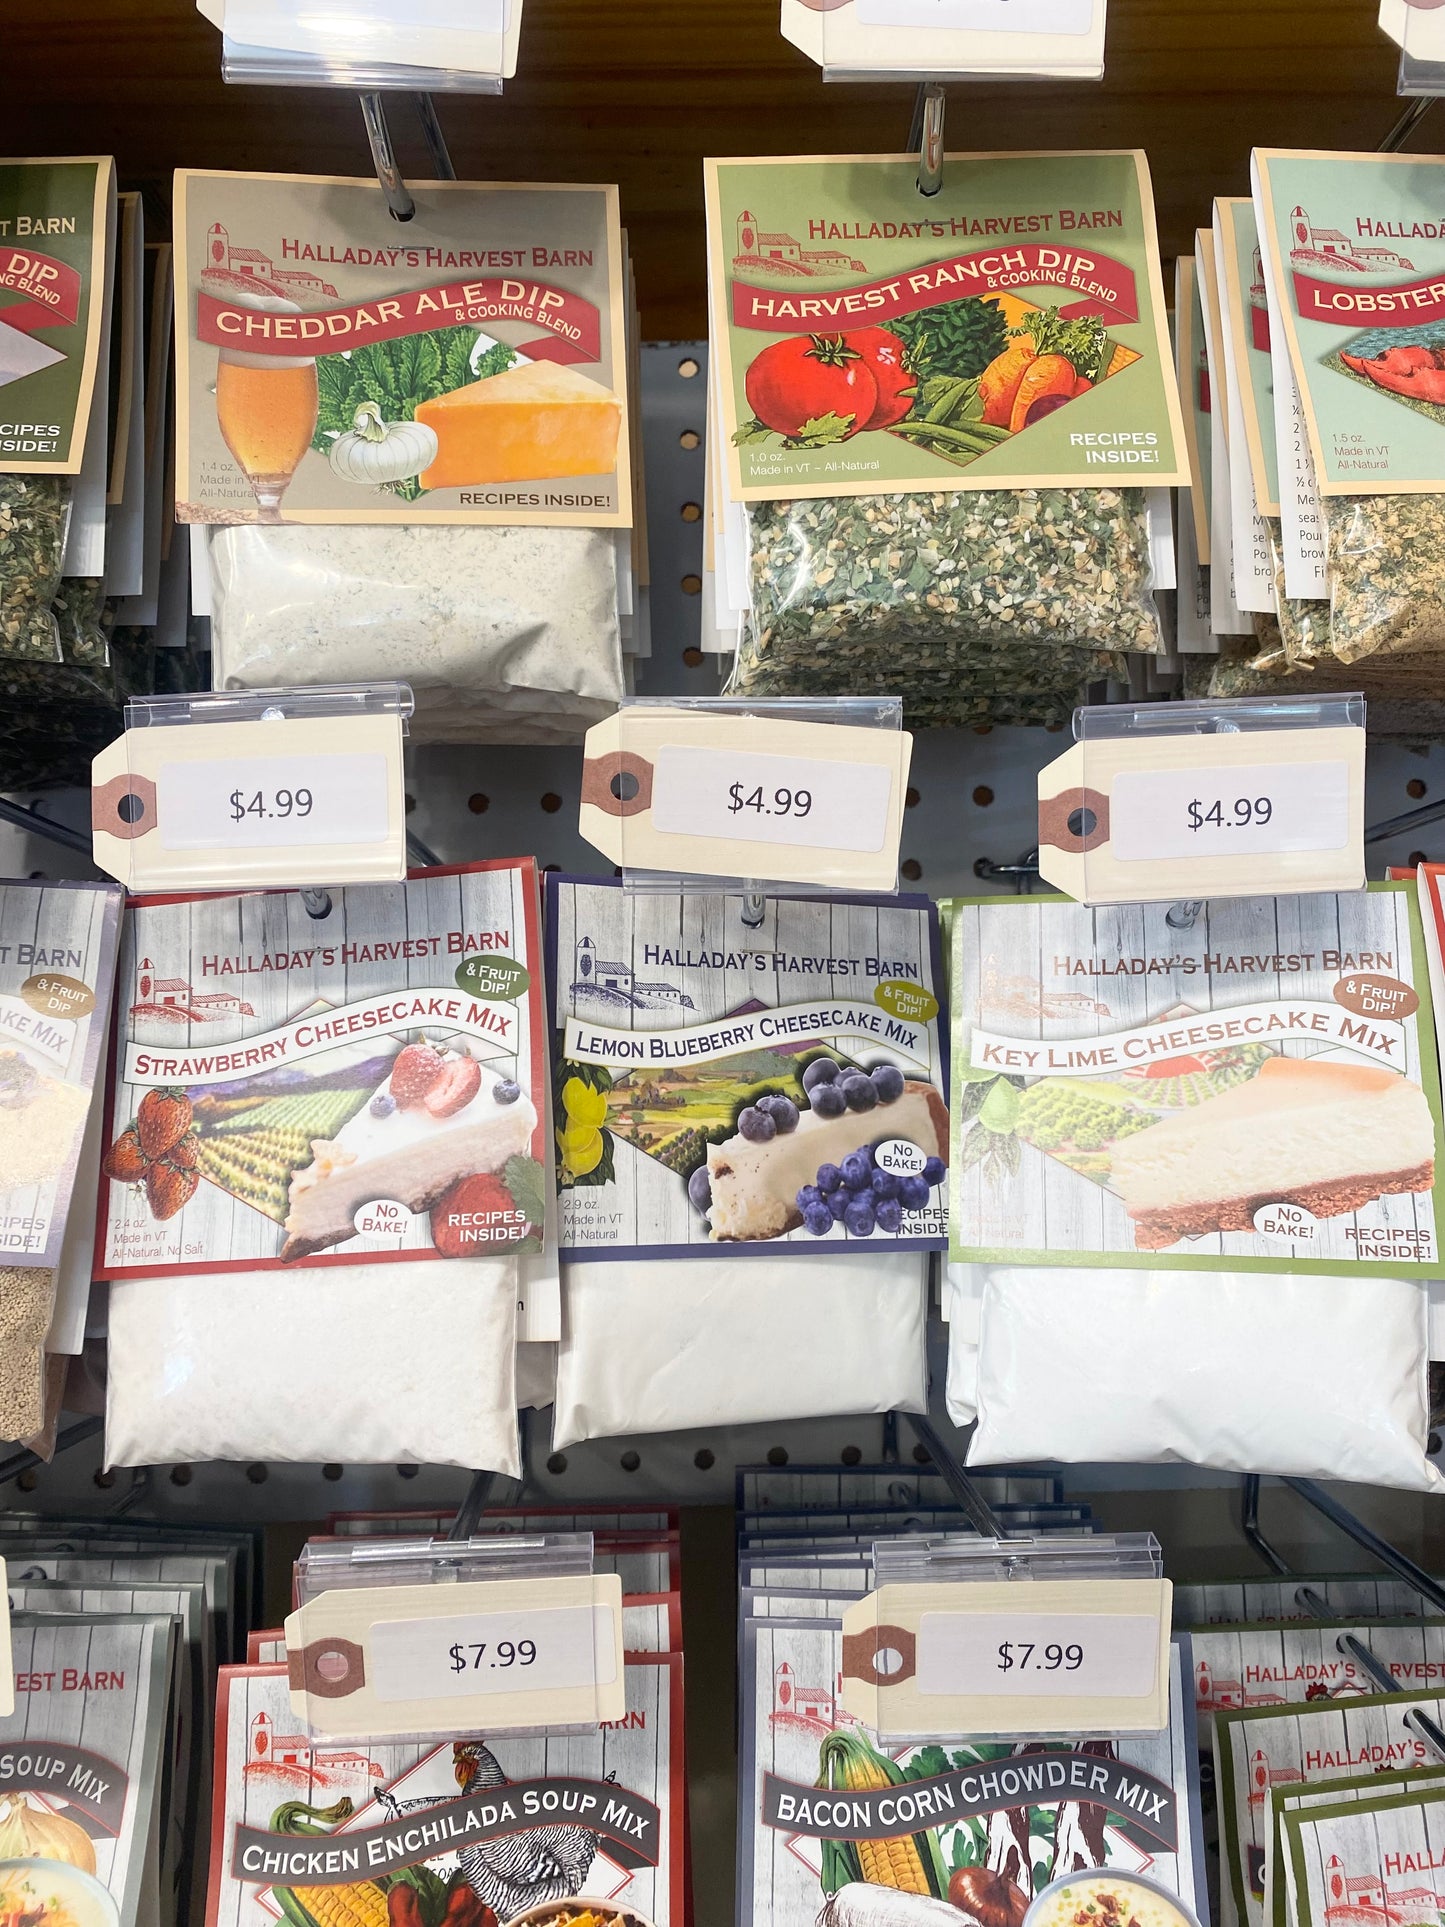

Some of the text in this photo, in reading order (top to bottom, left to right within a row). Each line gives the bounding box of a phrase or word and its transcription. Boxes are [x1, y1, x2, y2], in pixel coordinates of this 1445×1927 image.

[7, 254, 59, 283] DIP
[17, 277, 61, 305] BLEND
[751, 249, 1096, 318] HARVEST RANCH DIP
[986, 268, 1118, 302] & COOKING BLEND
[216, 280, 565, 340] CHEDDAR ALE DIP
[455, 303, 582, 341] & COOKING BLEND
[0, 424, 61, 437] CIPES
[1293, 422, 1300, 433] 2
[1294, 440, 1301, 451] 2
[1332, 433, 1348, 443] 1.5
[0, 440, 57, 452] SIDE!
[1070, 432, 1160, 463] RECIPES INSIDE!
[1334, 446, 1390, 456] Made in VT
[750, 453, 786, 462] 1.0 oz.
[1337, 460, 1389, 469] All-Natural
[201, 462, 217, 471] 1.4
[750, 465, 781, 476] Made
[783, 464, 793, 474] in
[796, 463, 811, 473] VT
[825, 460, 880, 471] All-Natural
[200, 475, 231, 485] Made
[235, 475, 244, 485] in
[459, 493, 611, 507] RECIPES INSIDE!
[1297, 494, 1315, 505] Me
[229, 788, 313, 823] $4.99
[727, 781, 812, 818] $4.99
[1187, 797, 1273, 832] $4.99
[466, 962, 521, 983] & FRUIT
[37, 979, 48, 990] &
[1346, 980, 1407, 1003] & FRUIT
[883, 986, 930, 1008] & FRUIT
[564, 1199, 600, 1210] 2.9 oz.
[448, 1210, 526, 1226] RECIPES
[564, 1213, 624, 1225] Made in VT
[900, 1208, 948, 1220] ECIPES
[114, 1219, 130, 1229] 2.4
[113, 1231, 168, 1244] Made in VT
[460, 1227, 526, 1242] INSIDE!
[563, 1229, 618, 1240] All-Natural
[1345, 1228, 1431, 1242] RECIPES
[168, 1246, 181, 1256] No
[185, 1241, 203, 1255] Salt
[1359, 1244, 1432, 1259] INSIDE!
[449, 1640, 537, 1674] $7.99
[997, 1641, 1084, 1673] $7.99
[777, 1760, 1169, 1828] BACON CORN CHOWDER MIX
